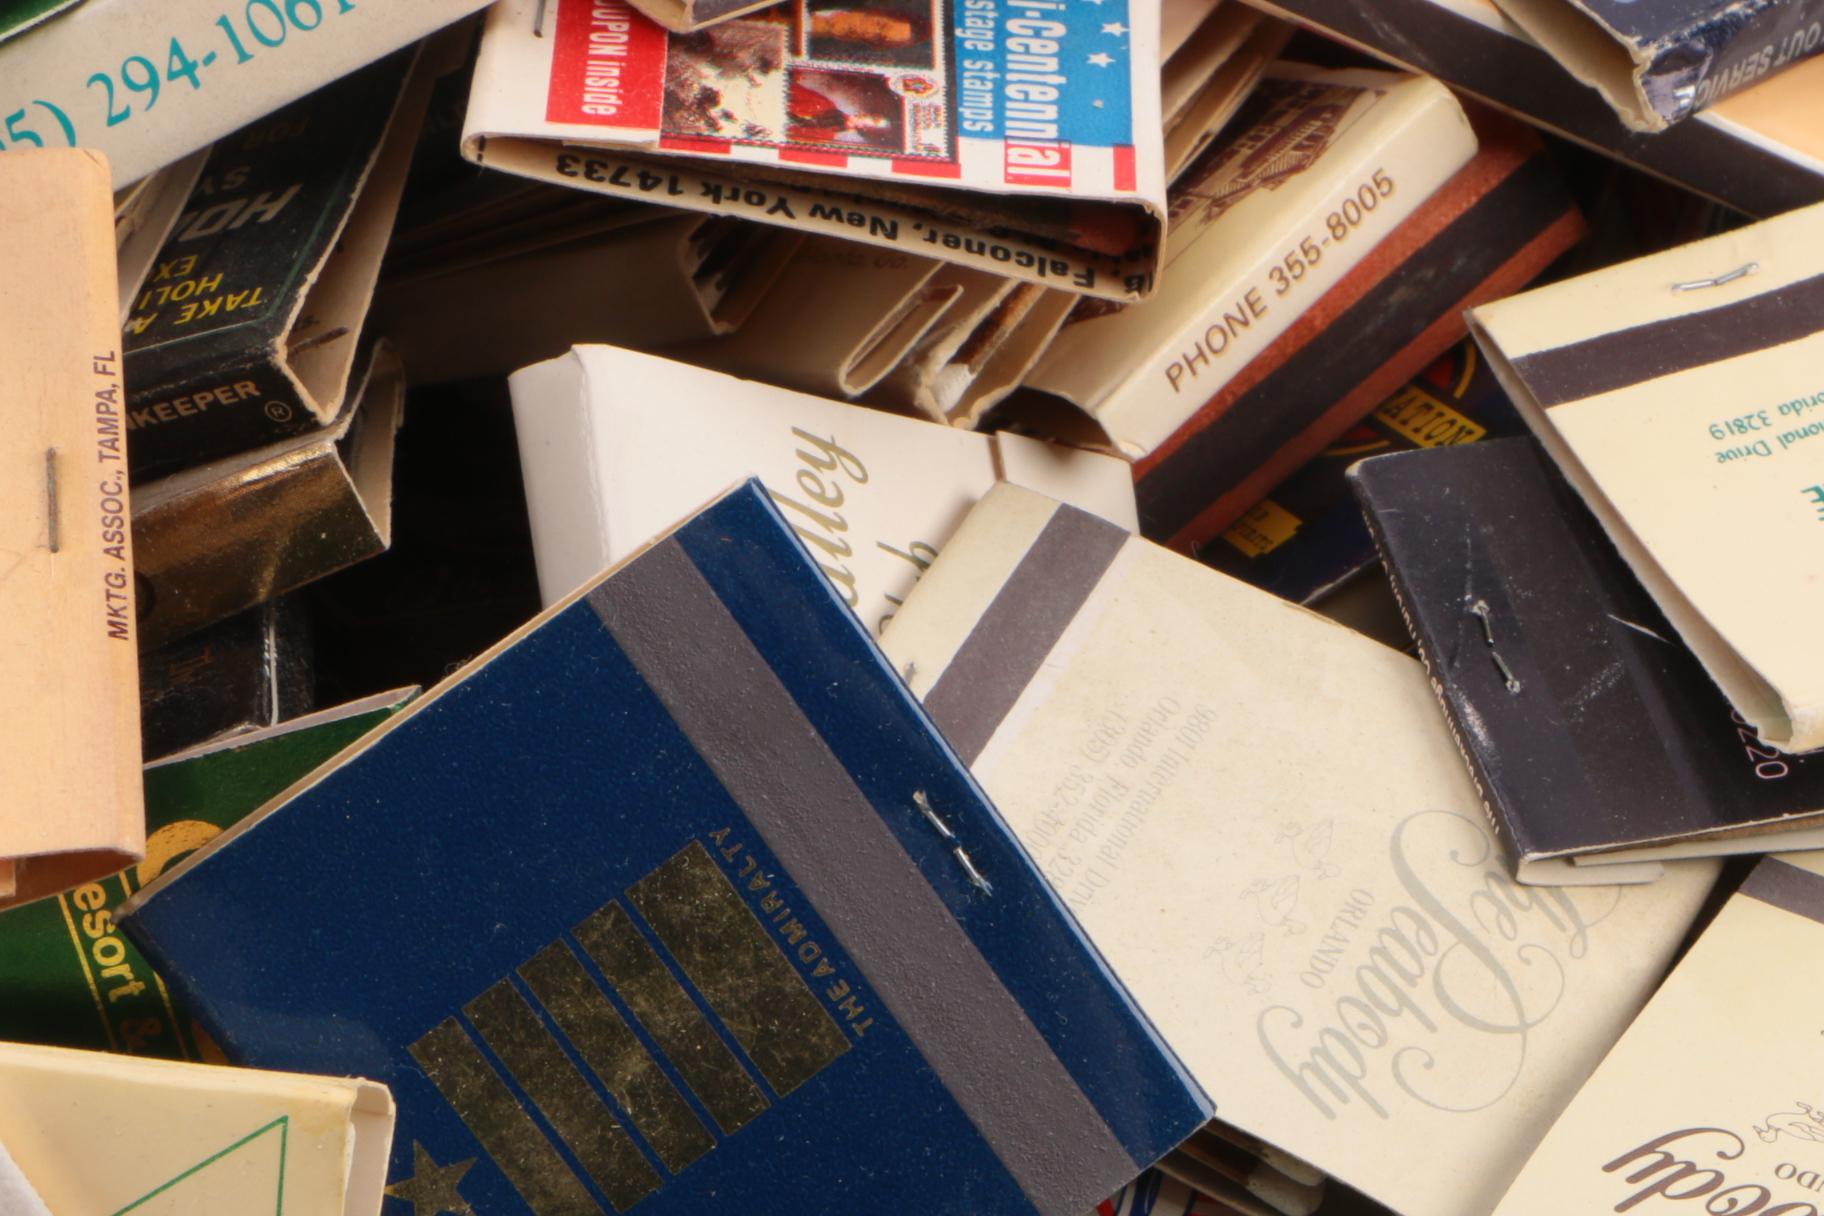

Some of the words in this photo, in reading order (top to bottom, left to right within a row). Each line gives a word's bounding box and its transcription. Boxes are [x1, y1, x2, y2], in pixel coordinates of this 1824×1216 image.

[958, 0, 993, 50] stage
[582, 64, 620, 117] inside
[961, 60, 996, 133] stamps
[1004, 0, 1073, 186] i-Centennial
[554, 152, 685, 196] 14733
[701, 178, 797, 220] York
[807, 199, 900, 242] New
[914, 219, 1095, 291] Falconer,
[174, 285, 264, 325] TAKE
[1162, 297, 1269, 394] PHONE
[1267, 167, 1397, 299] 355-8005
[93, 349, 116, 375] FL
[95, 381, 123, 461] TAMPA,
[1707, 408, 1772, 442] 32819
[1714, 439, 1773, 465] Drive
[101, 467, 127, 560] ASSOC.,
[107, 570, 131, 641] MKTG.
[1174, 702, 1218, 752] 9801
[1068, 774, 1131, 845] Florida
[1094, 745, 1190, 872] International
[709, 825, 834, 989] ADMIRALTY
[1300, 887, 1375, 991] ORLANDO
[1256, 808, 1567, 1122] Peabody
[825, 988, 874, 1038] THE
